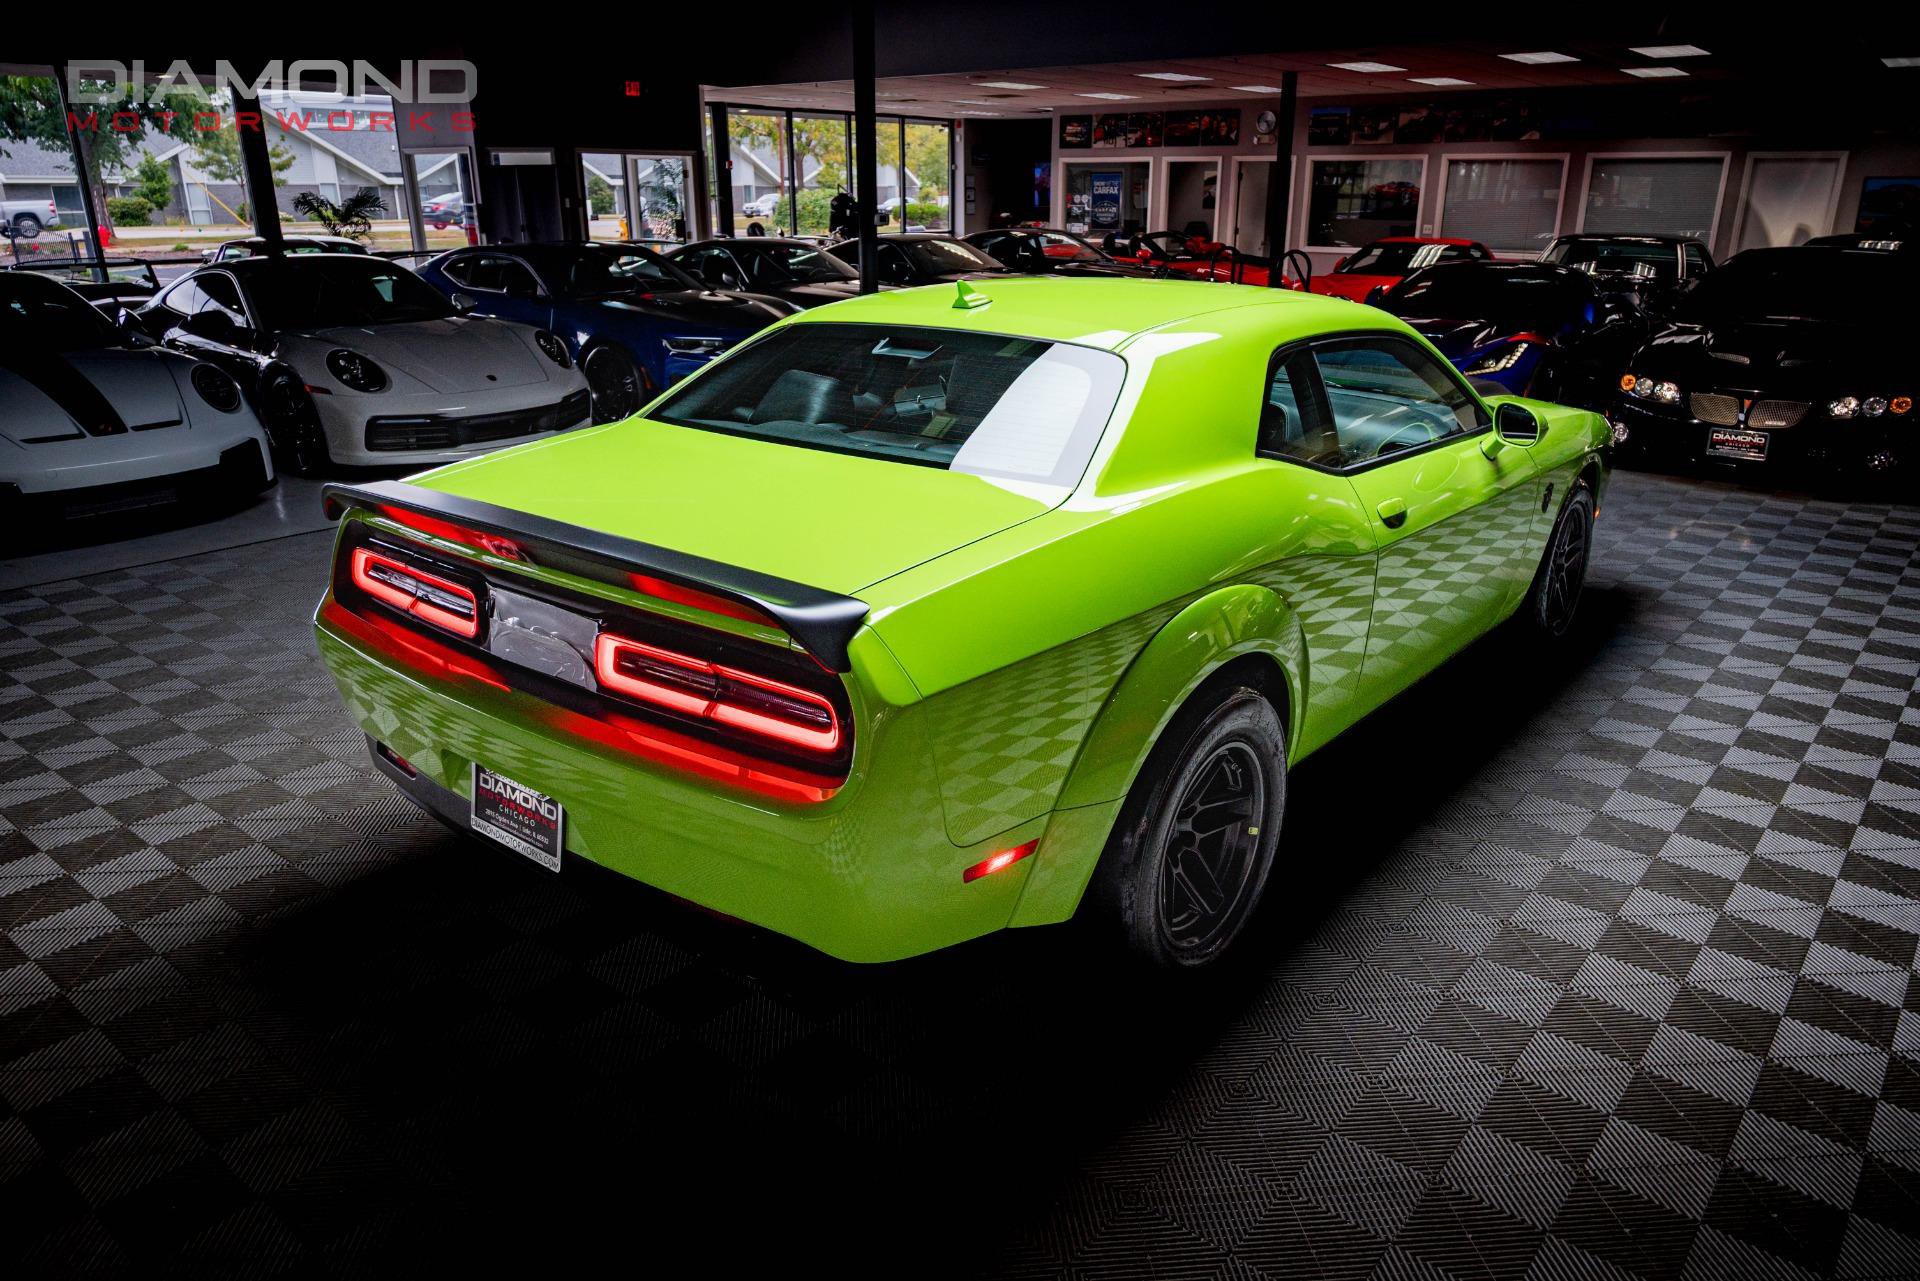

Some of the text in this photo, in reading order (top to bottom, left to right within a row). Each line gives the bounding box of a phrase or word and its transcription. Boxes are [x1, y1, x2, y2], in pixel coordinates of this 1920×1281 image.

[1093, 186, 1118, 194] CARFAX
[1713, 433, 1765, 443] DIAMOND
[479, 772, 557, 821] DIAMOND
[498, 804, 536, 827] CHICAGO
[472, 818, 559, 870] DIAMONDMOTORWORKS.COM
